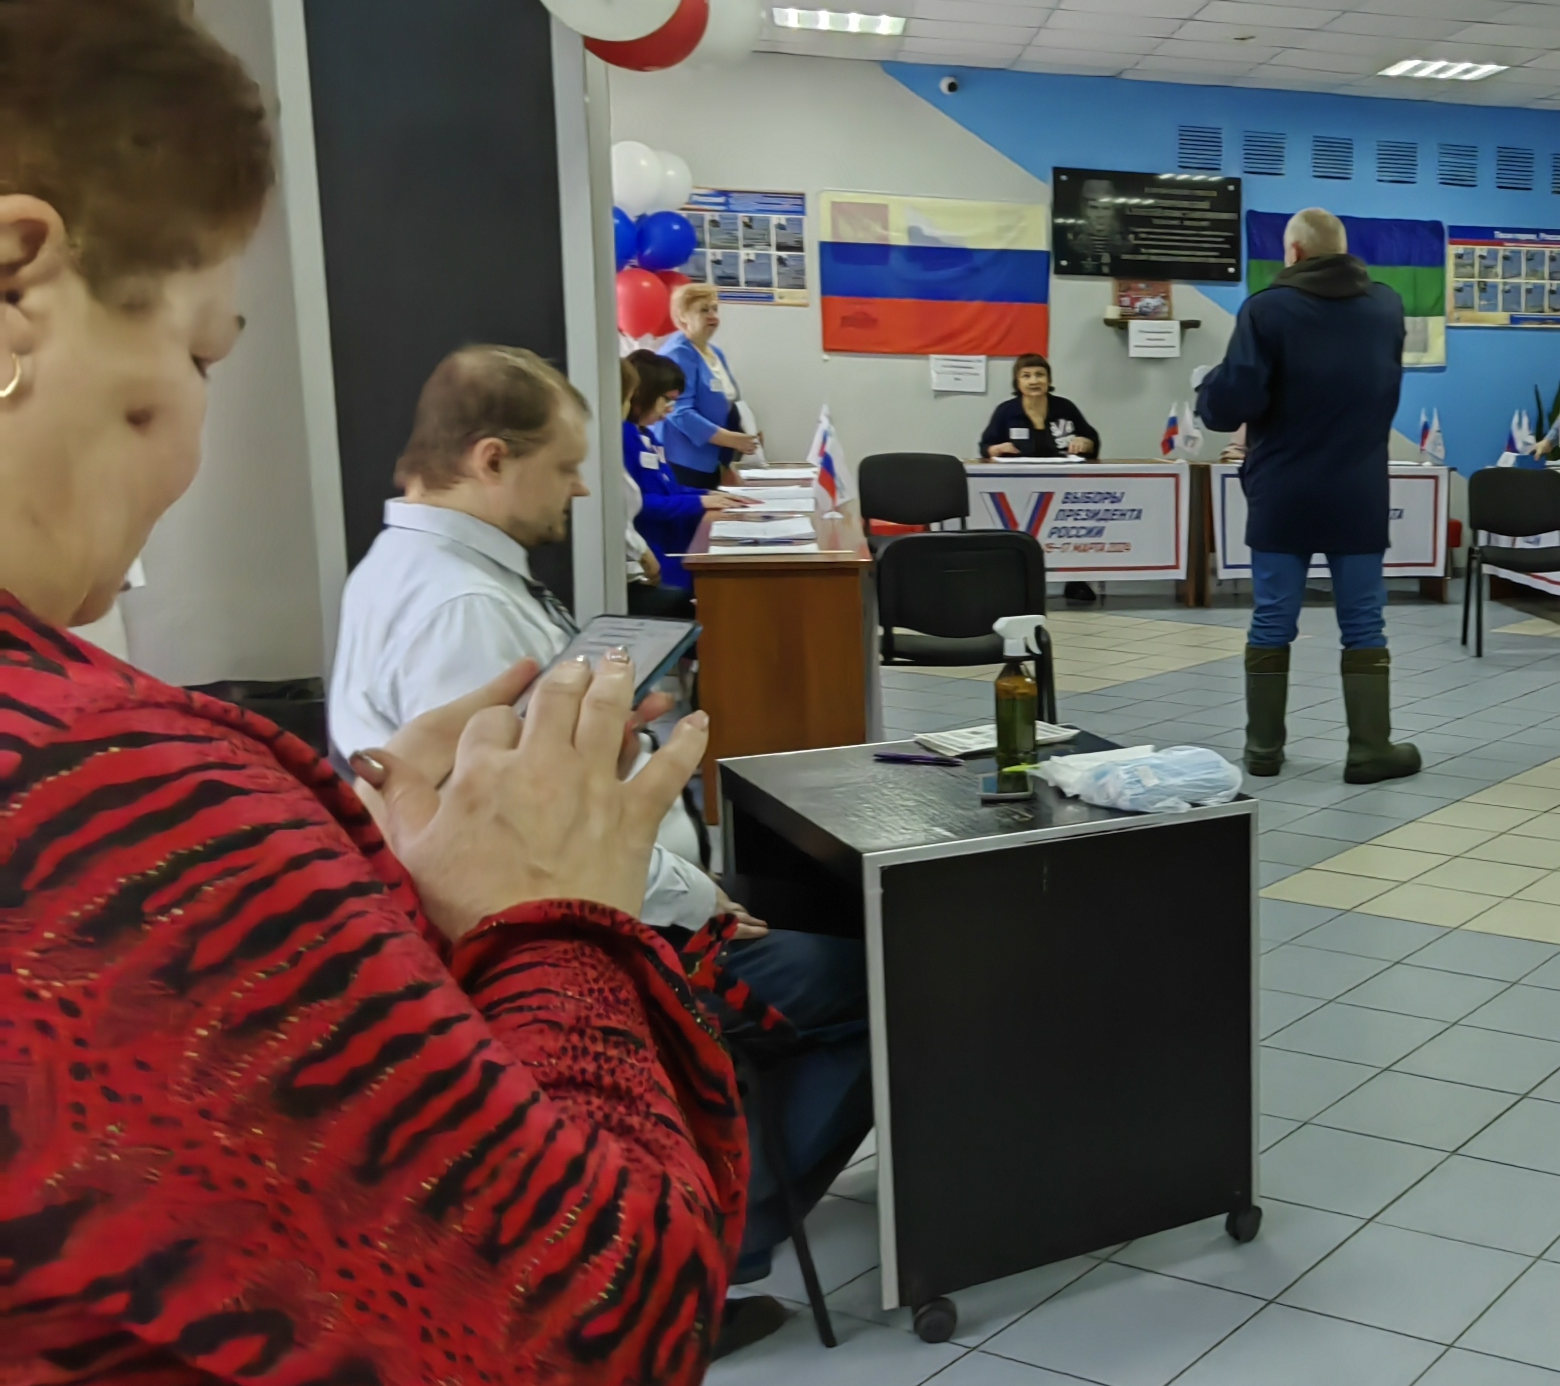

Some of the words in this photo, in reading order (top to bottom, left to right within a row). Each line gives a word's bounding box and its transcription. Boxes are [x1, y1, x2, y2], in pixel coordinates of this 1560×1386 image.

[1061, 491, 1125, 505] ВЫБОРЫ
[1053, 508, 1143, 522] ПРЕЗИДЕНТА
[1048, 525, 1106, 539] РОССИИ
